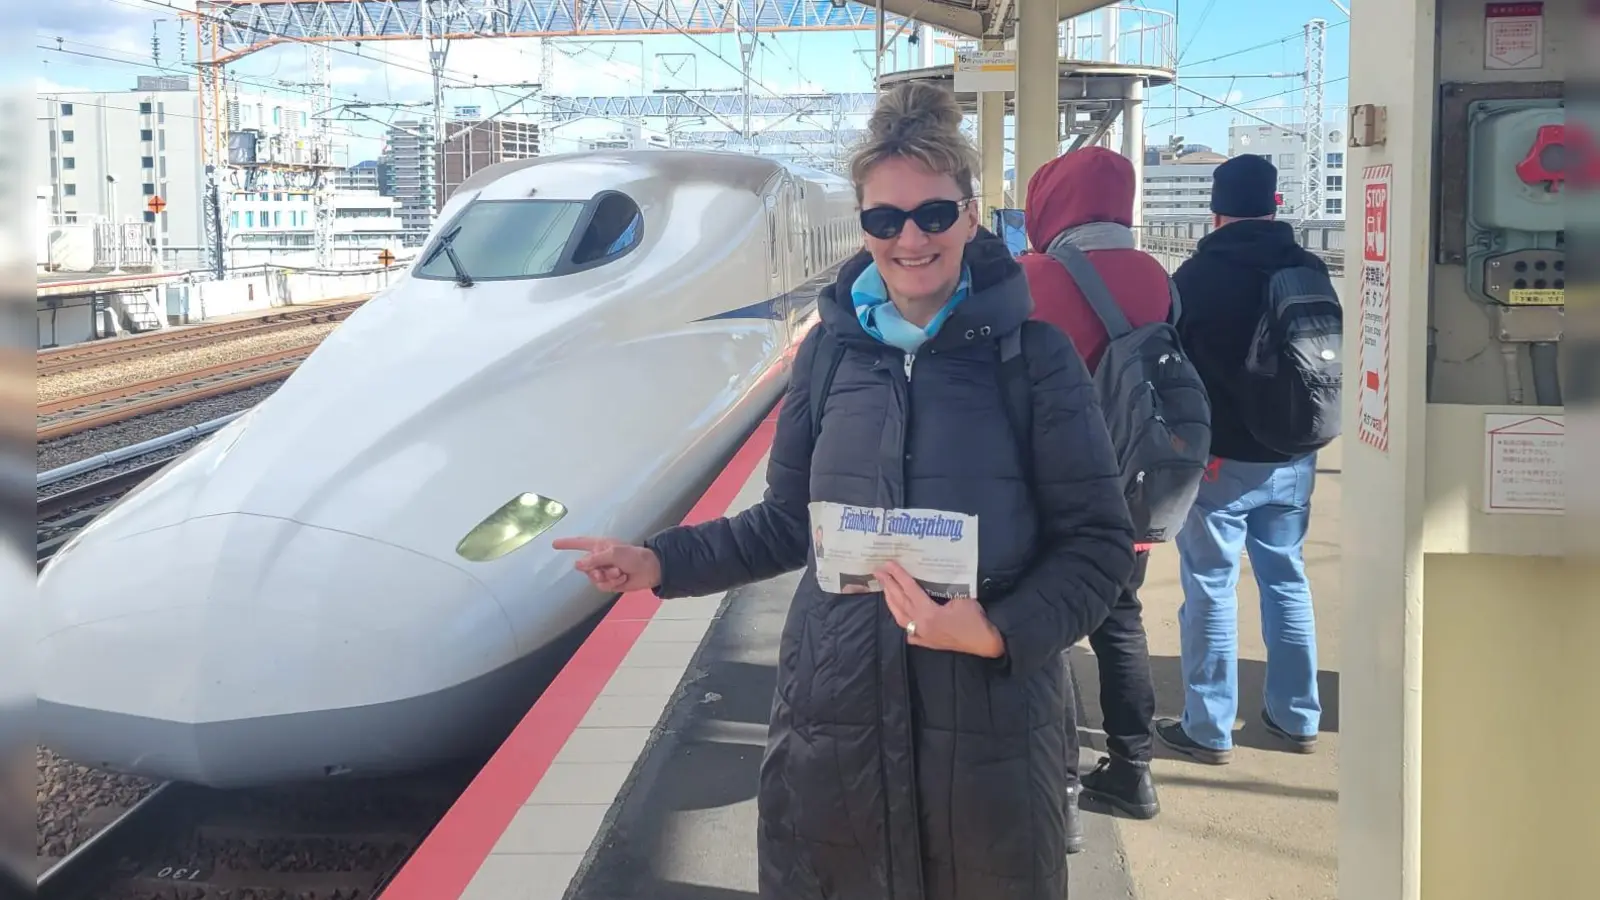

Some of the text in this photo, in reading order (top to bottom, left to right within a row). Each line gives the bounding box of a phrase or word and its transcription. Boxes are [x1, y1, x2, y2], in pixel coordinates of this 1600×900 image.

[957, 54, 967, 64] 16
[1366, 189, 1386, 208] STOP
[878, 509, 964, 542] Landeszeitung
[157, 866, 200, 880] 130
